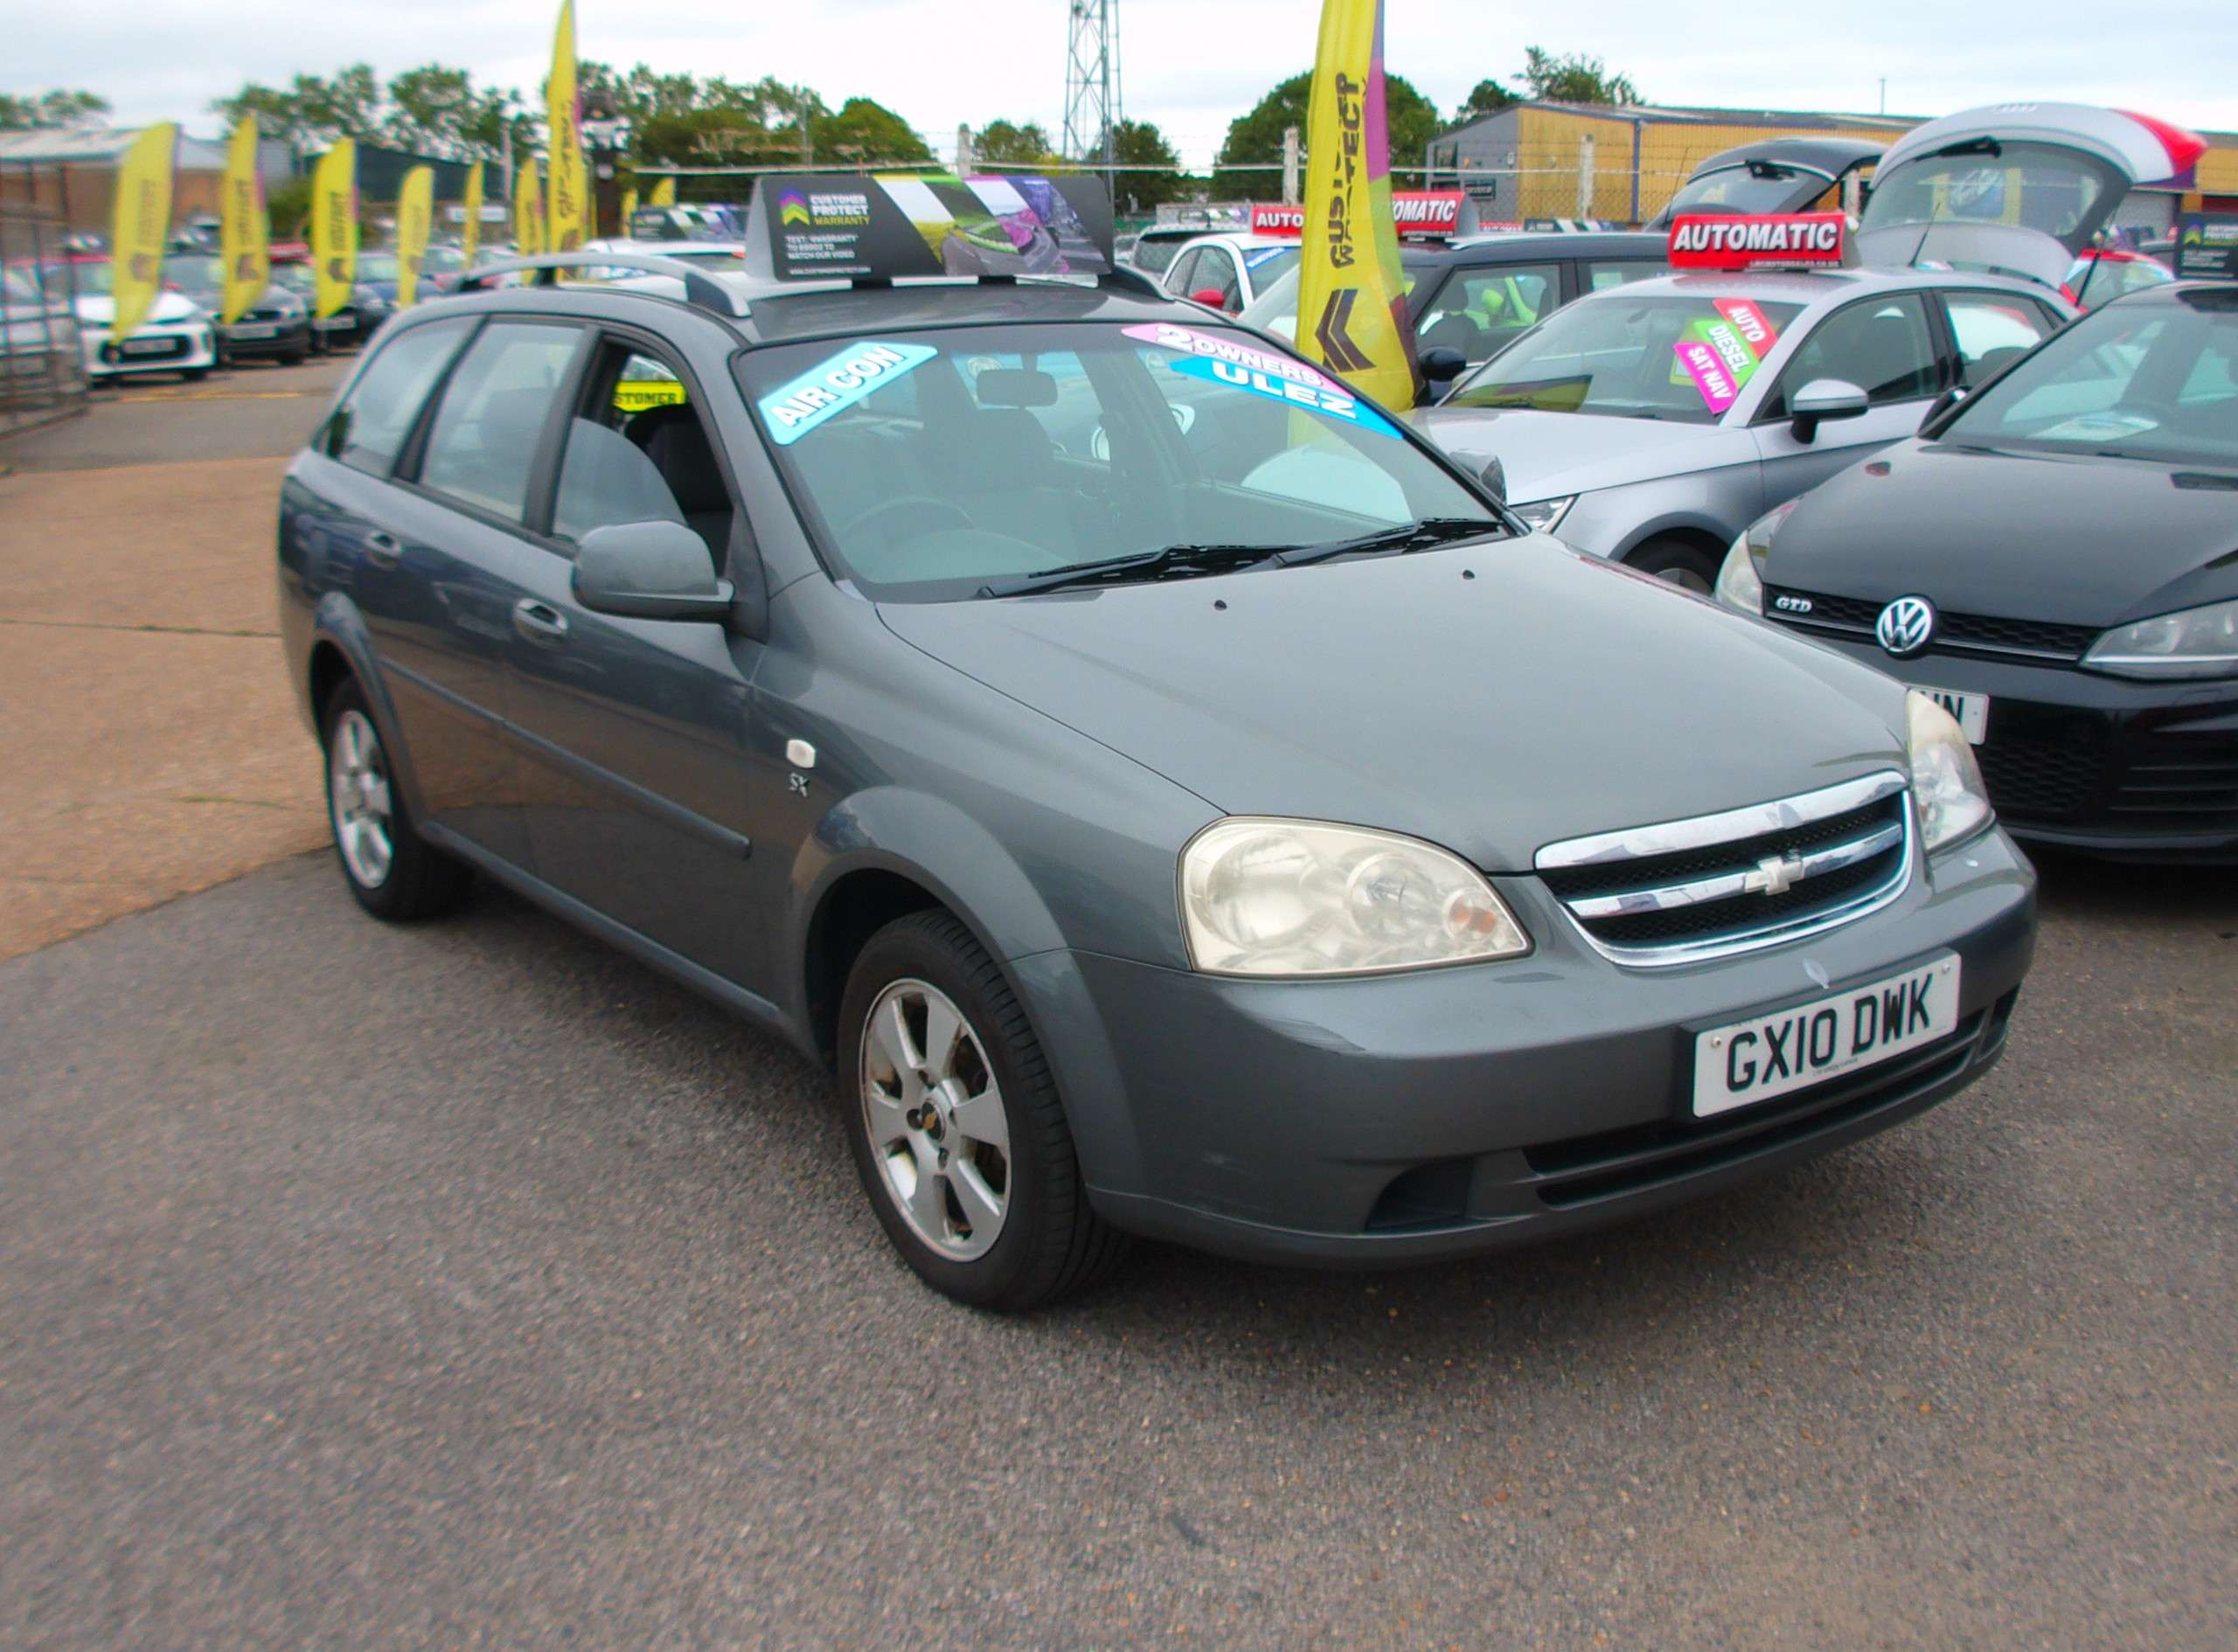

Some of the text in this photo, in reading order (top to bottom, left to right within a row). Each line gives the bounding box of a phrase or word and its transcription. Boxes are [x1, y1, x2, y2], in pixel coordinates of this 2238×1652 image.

[810, 194, 867, 205] CUSTOMER
[811, 205, 868, 216] PROTECT
[1393, 199, 1456, 222] OMATIC
[814, 216, 870, 225] WARRANTY
[1673, 223, 1838, 251] AUTOMATIC
[1728, 307, 1766, 342] AUTO
[1708, 323, 1750, 373] DIESEL
[769, 345, 907, 427] AIR CON
[1687, 346, 1733, 399] SAT NAV
[1212, 359, 1357, 420] ULEZ
[1775, 595, 1813, 613] GTD
[1727, 973, 1933, 1093] GX10 DWK
